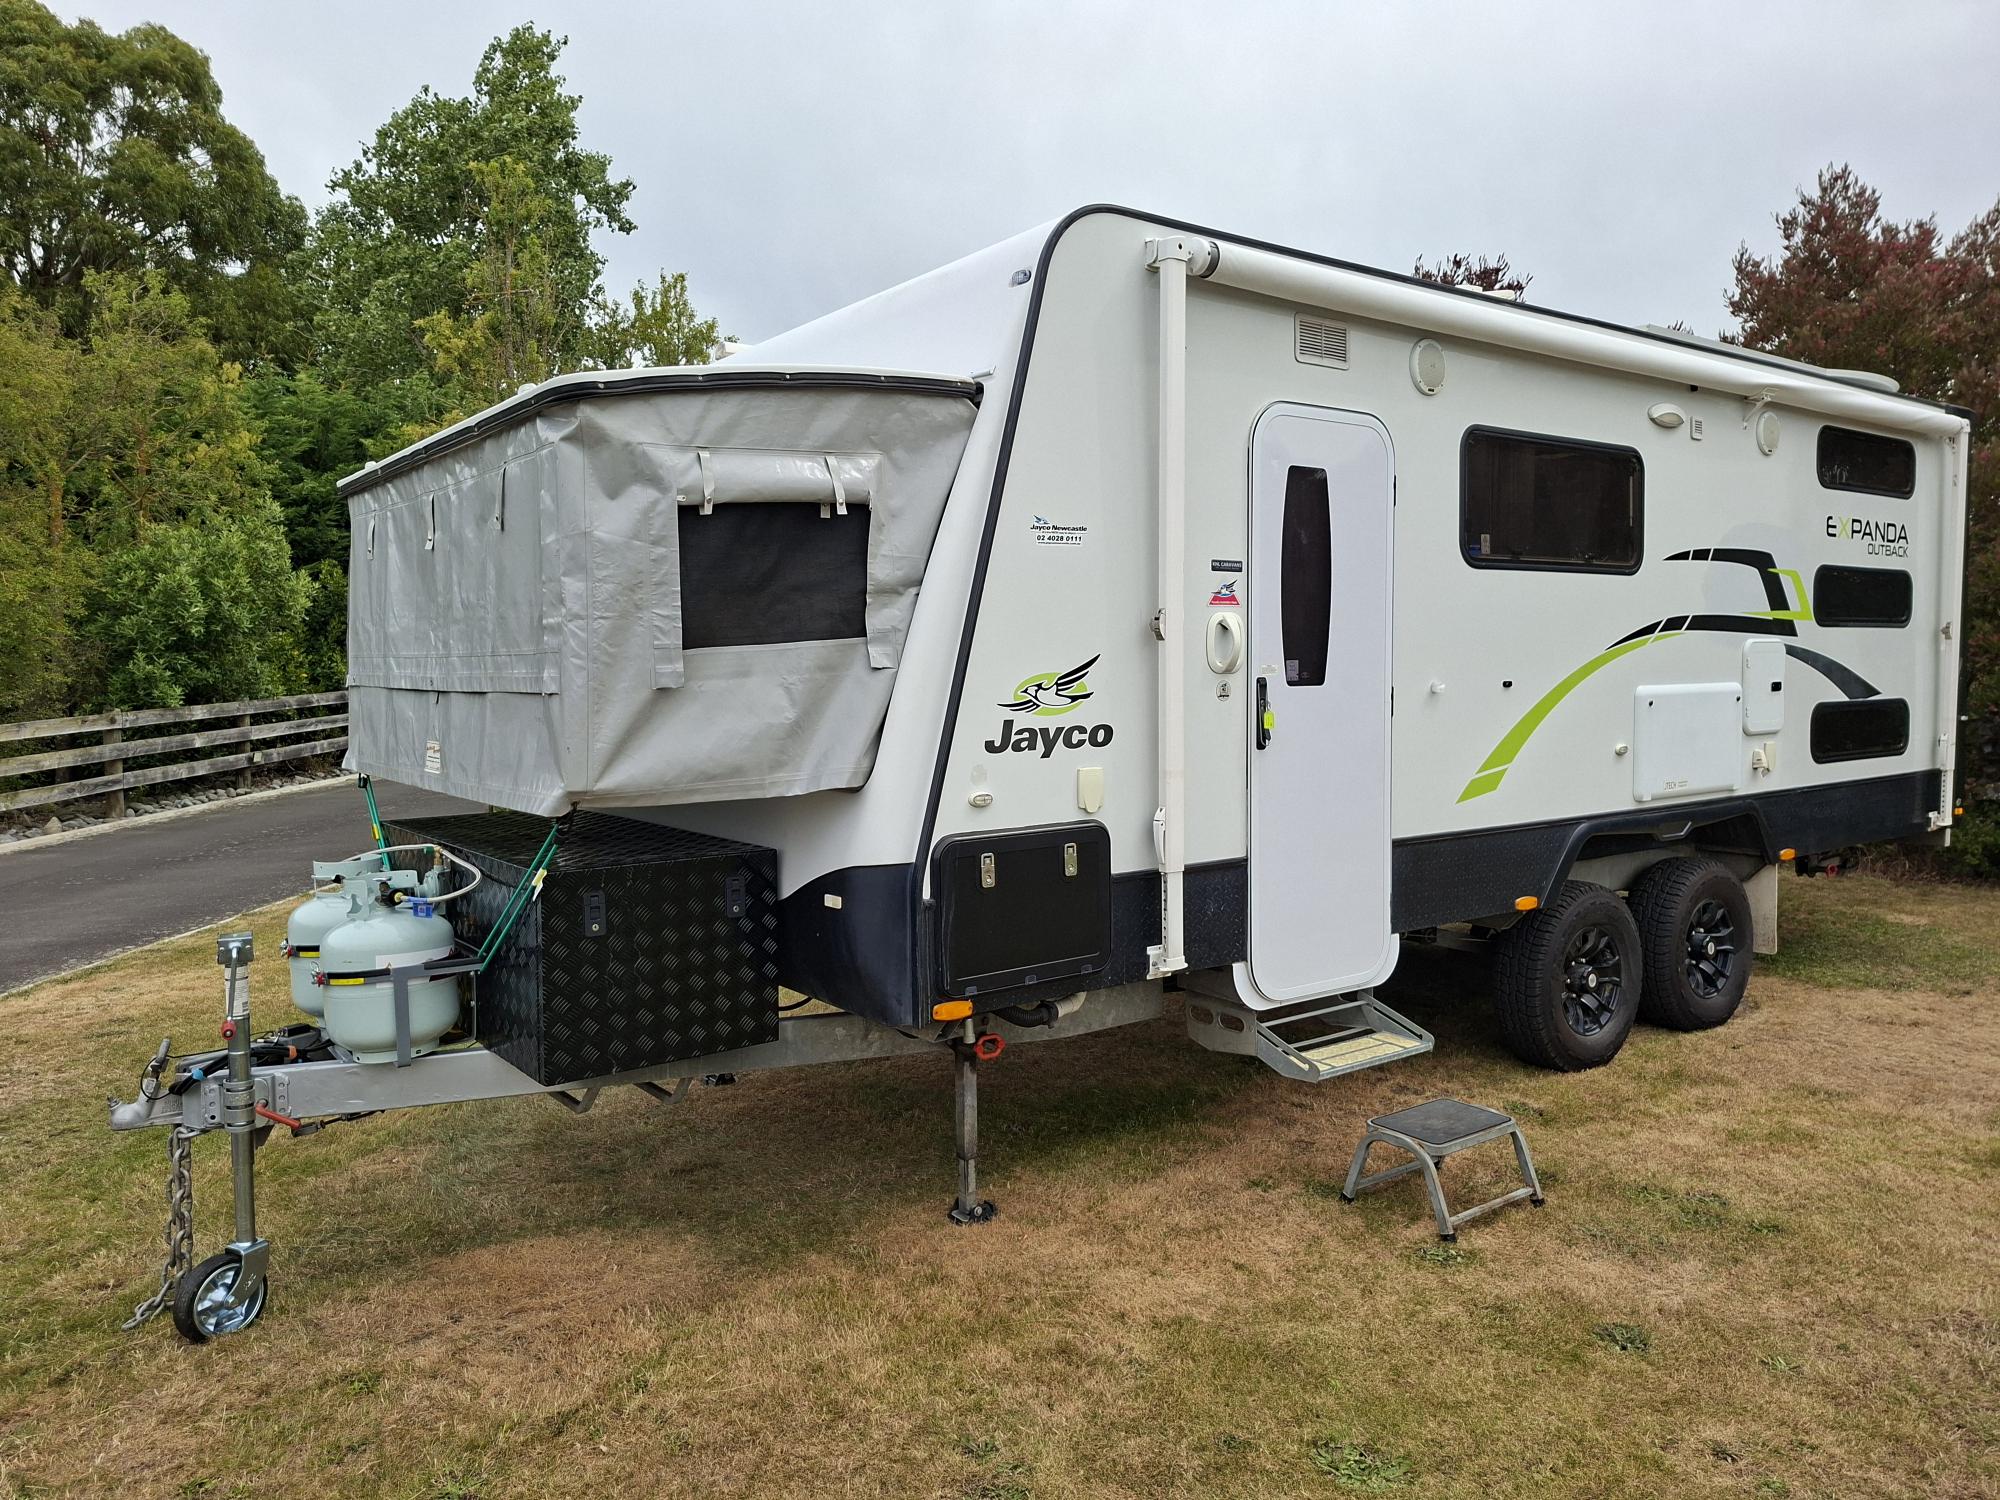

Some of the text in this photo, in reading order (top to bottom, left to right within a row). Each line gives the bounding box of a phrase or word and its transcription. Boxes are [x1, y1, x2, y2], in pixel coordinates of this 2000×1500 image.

[1826, 515, 1909, 545] EXPANDA
[1867, 543, 1909, 558] OUTBACK
[984, 719, 1114, 759] Jayco
